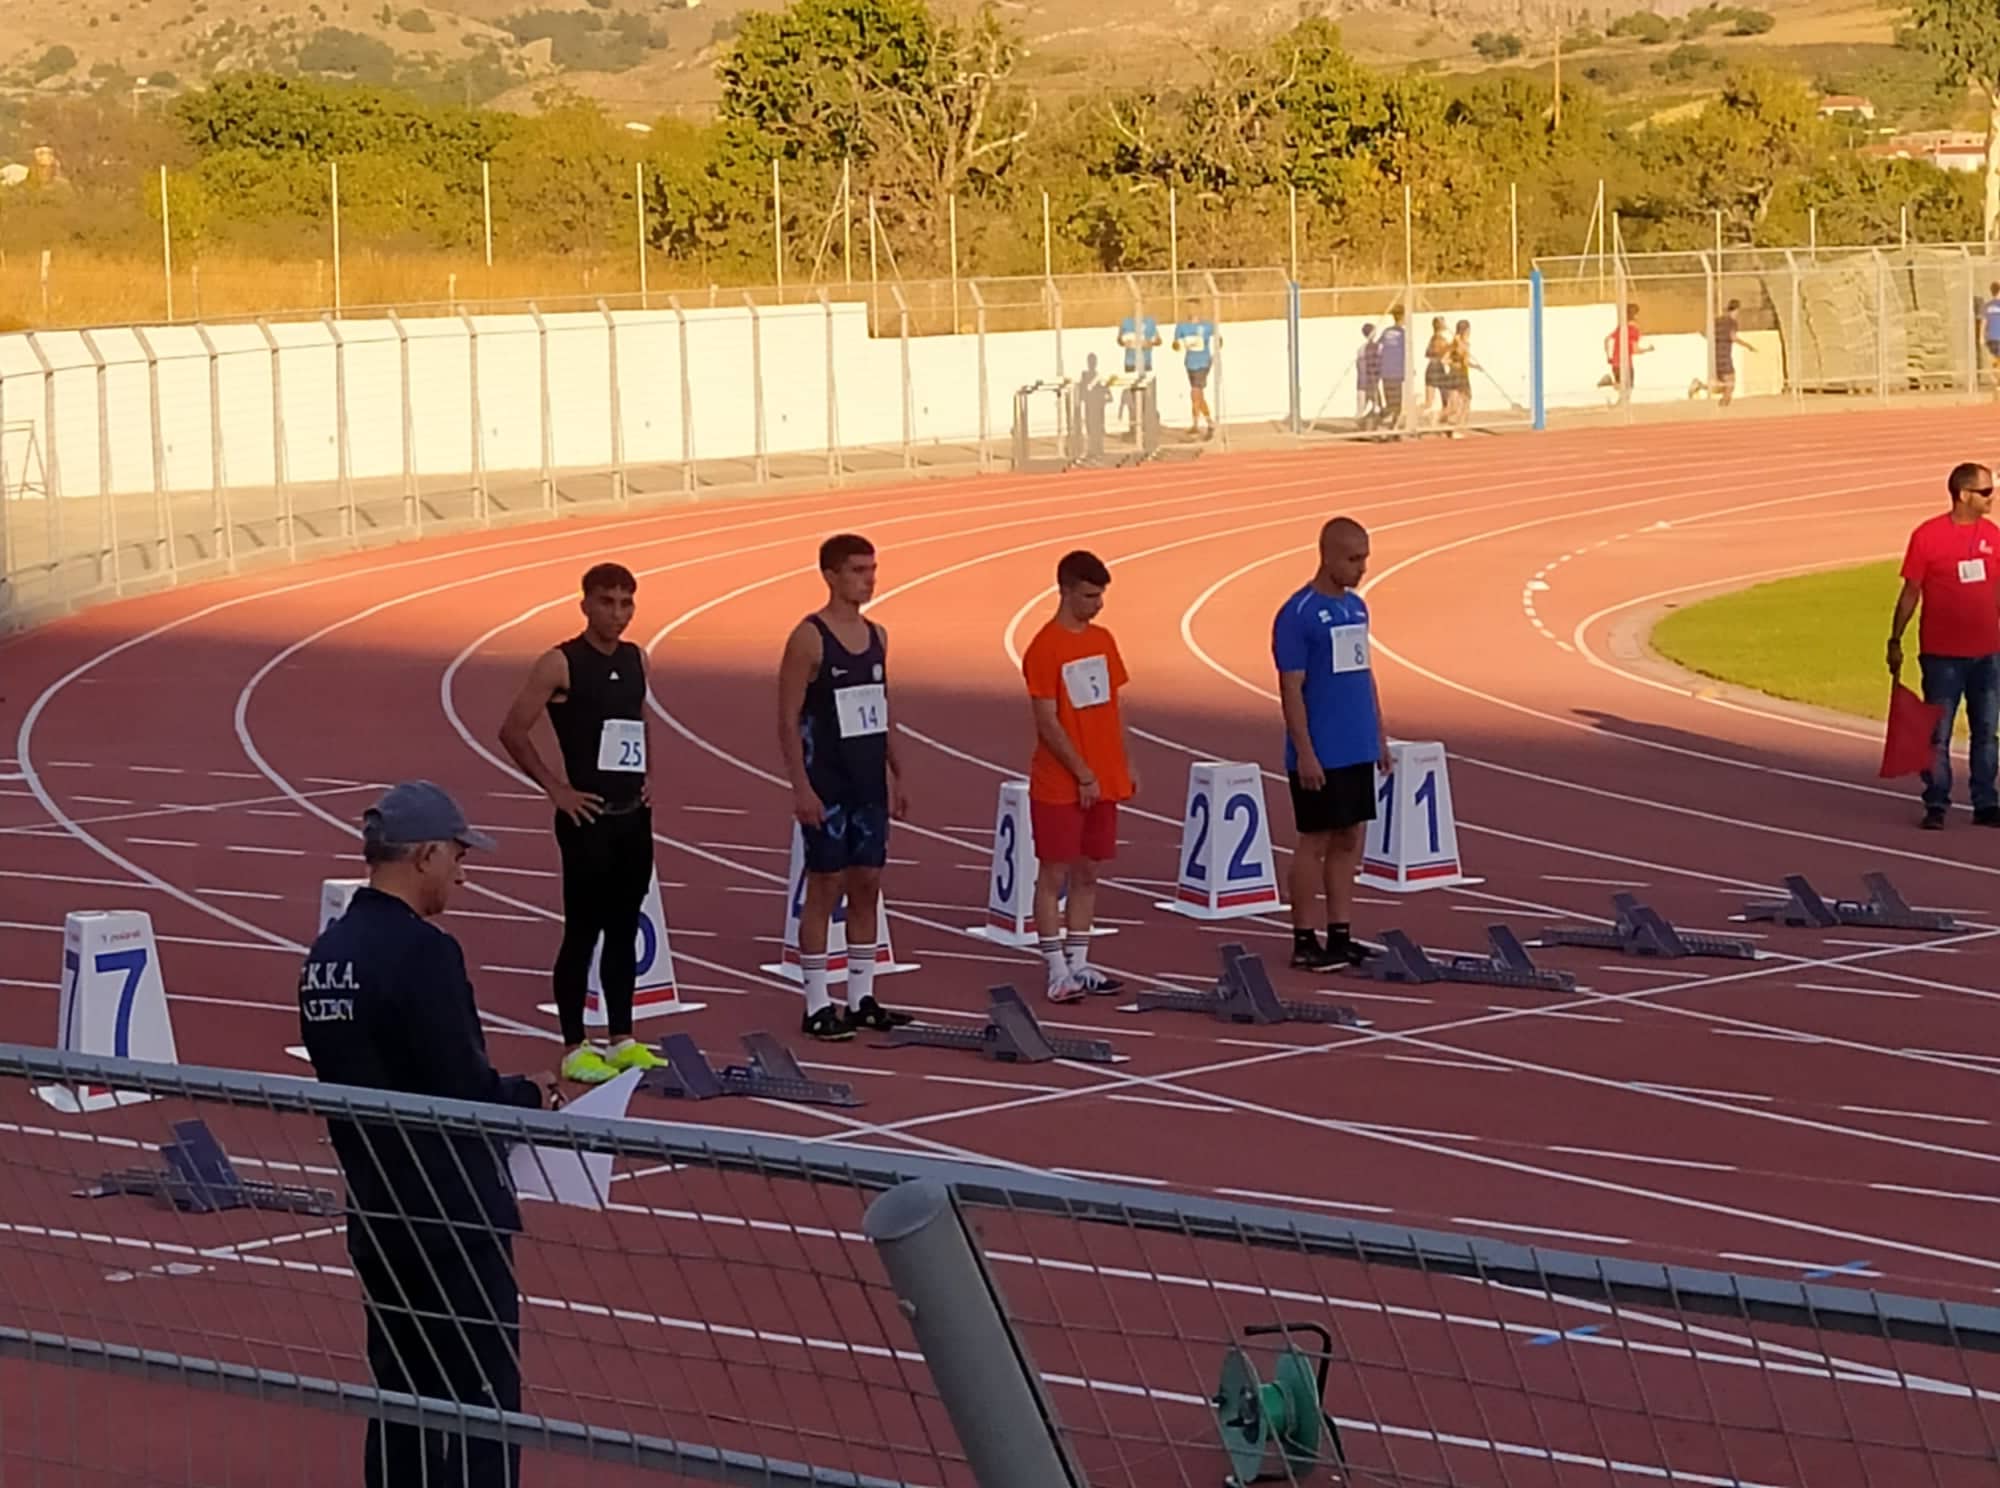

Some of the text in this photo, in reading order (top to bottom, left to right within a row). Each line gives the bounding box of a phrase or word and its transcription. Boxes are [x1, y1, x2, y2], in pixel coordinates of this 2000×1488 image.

[1353, 642, 1365, 666] 8
[618, 740, 643, 767] 25
[857, 704, 879, 730] 14
[1185, 791, 1210, 881] 2
[1223, 792, 1263, 882] 2
[1378, 772, 1395, 855] 1
[1414, 769, 1440, 854] 1
[996, 813, 1016, 903] 3
[94, 948, 148, 1058] 7
[301, 961, 361, 992] .Κ.Κ.Α.
